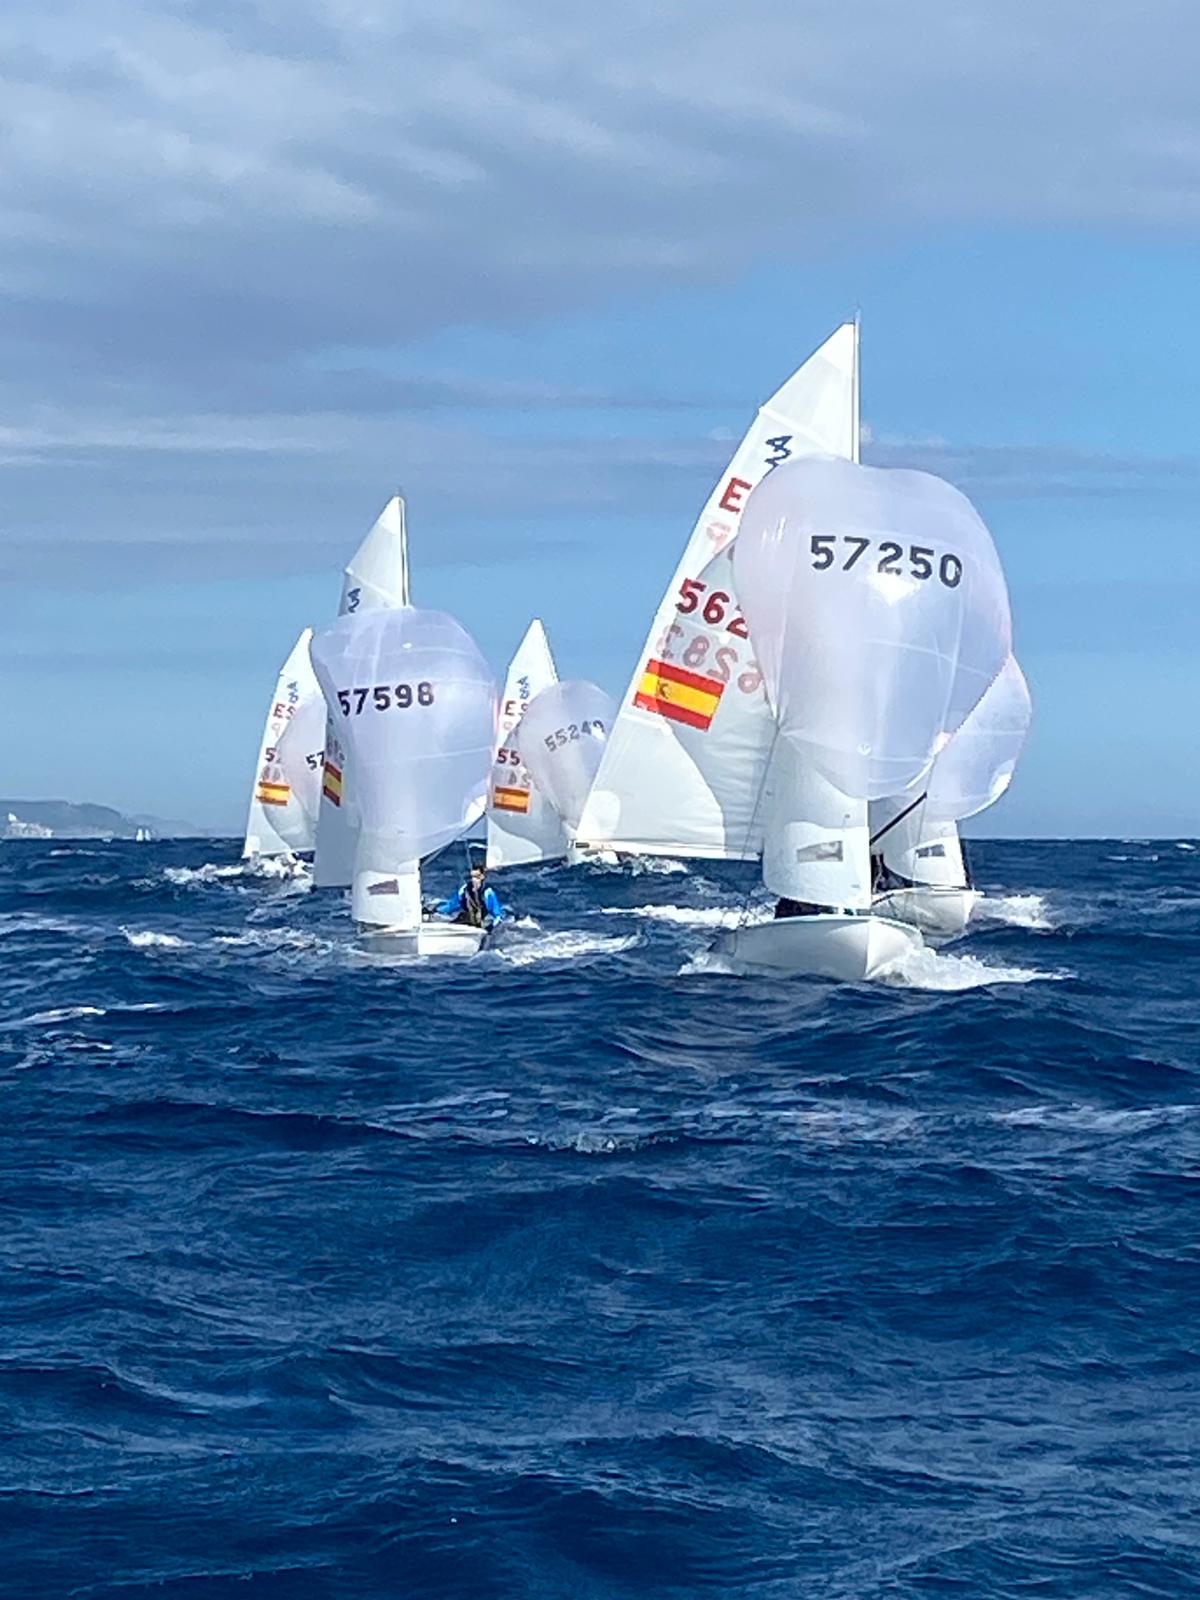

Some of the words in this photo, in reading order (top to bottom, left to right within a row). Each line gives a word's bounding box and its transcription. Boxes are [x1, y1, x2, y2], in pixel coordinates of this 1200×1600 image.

[810, 535, 963, 588] 57250
[337, 681, 435, 717] 57598
[305, 751, 325, 771] 57
[497, 748, 520, 766] 55
